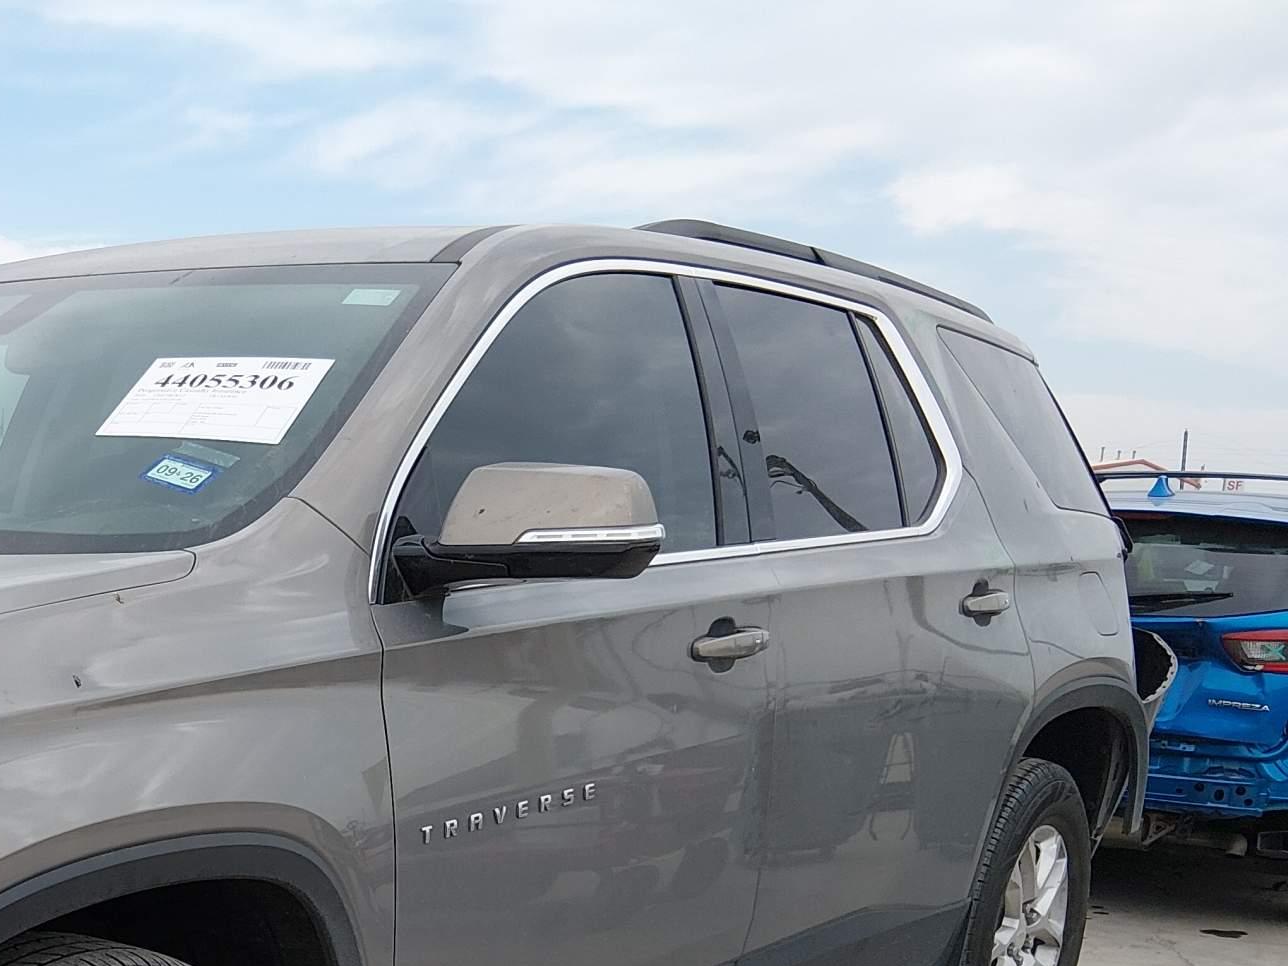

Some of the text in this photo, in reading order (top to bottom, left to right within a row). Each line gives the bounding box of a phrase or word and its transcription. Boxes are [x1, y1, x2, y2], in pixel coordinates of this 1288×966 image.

[155, 373, 300, 391] 44055306
[156, 464, 203, 484] 09 26
[1208, 699, 1270, 712] IMPREZA
[420, 783, 597, 844] TRAVERSE
